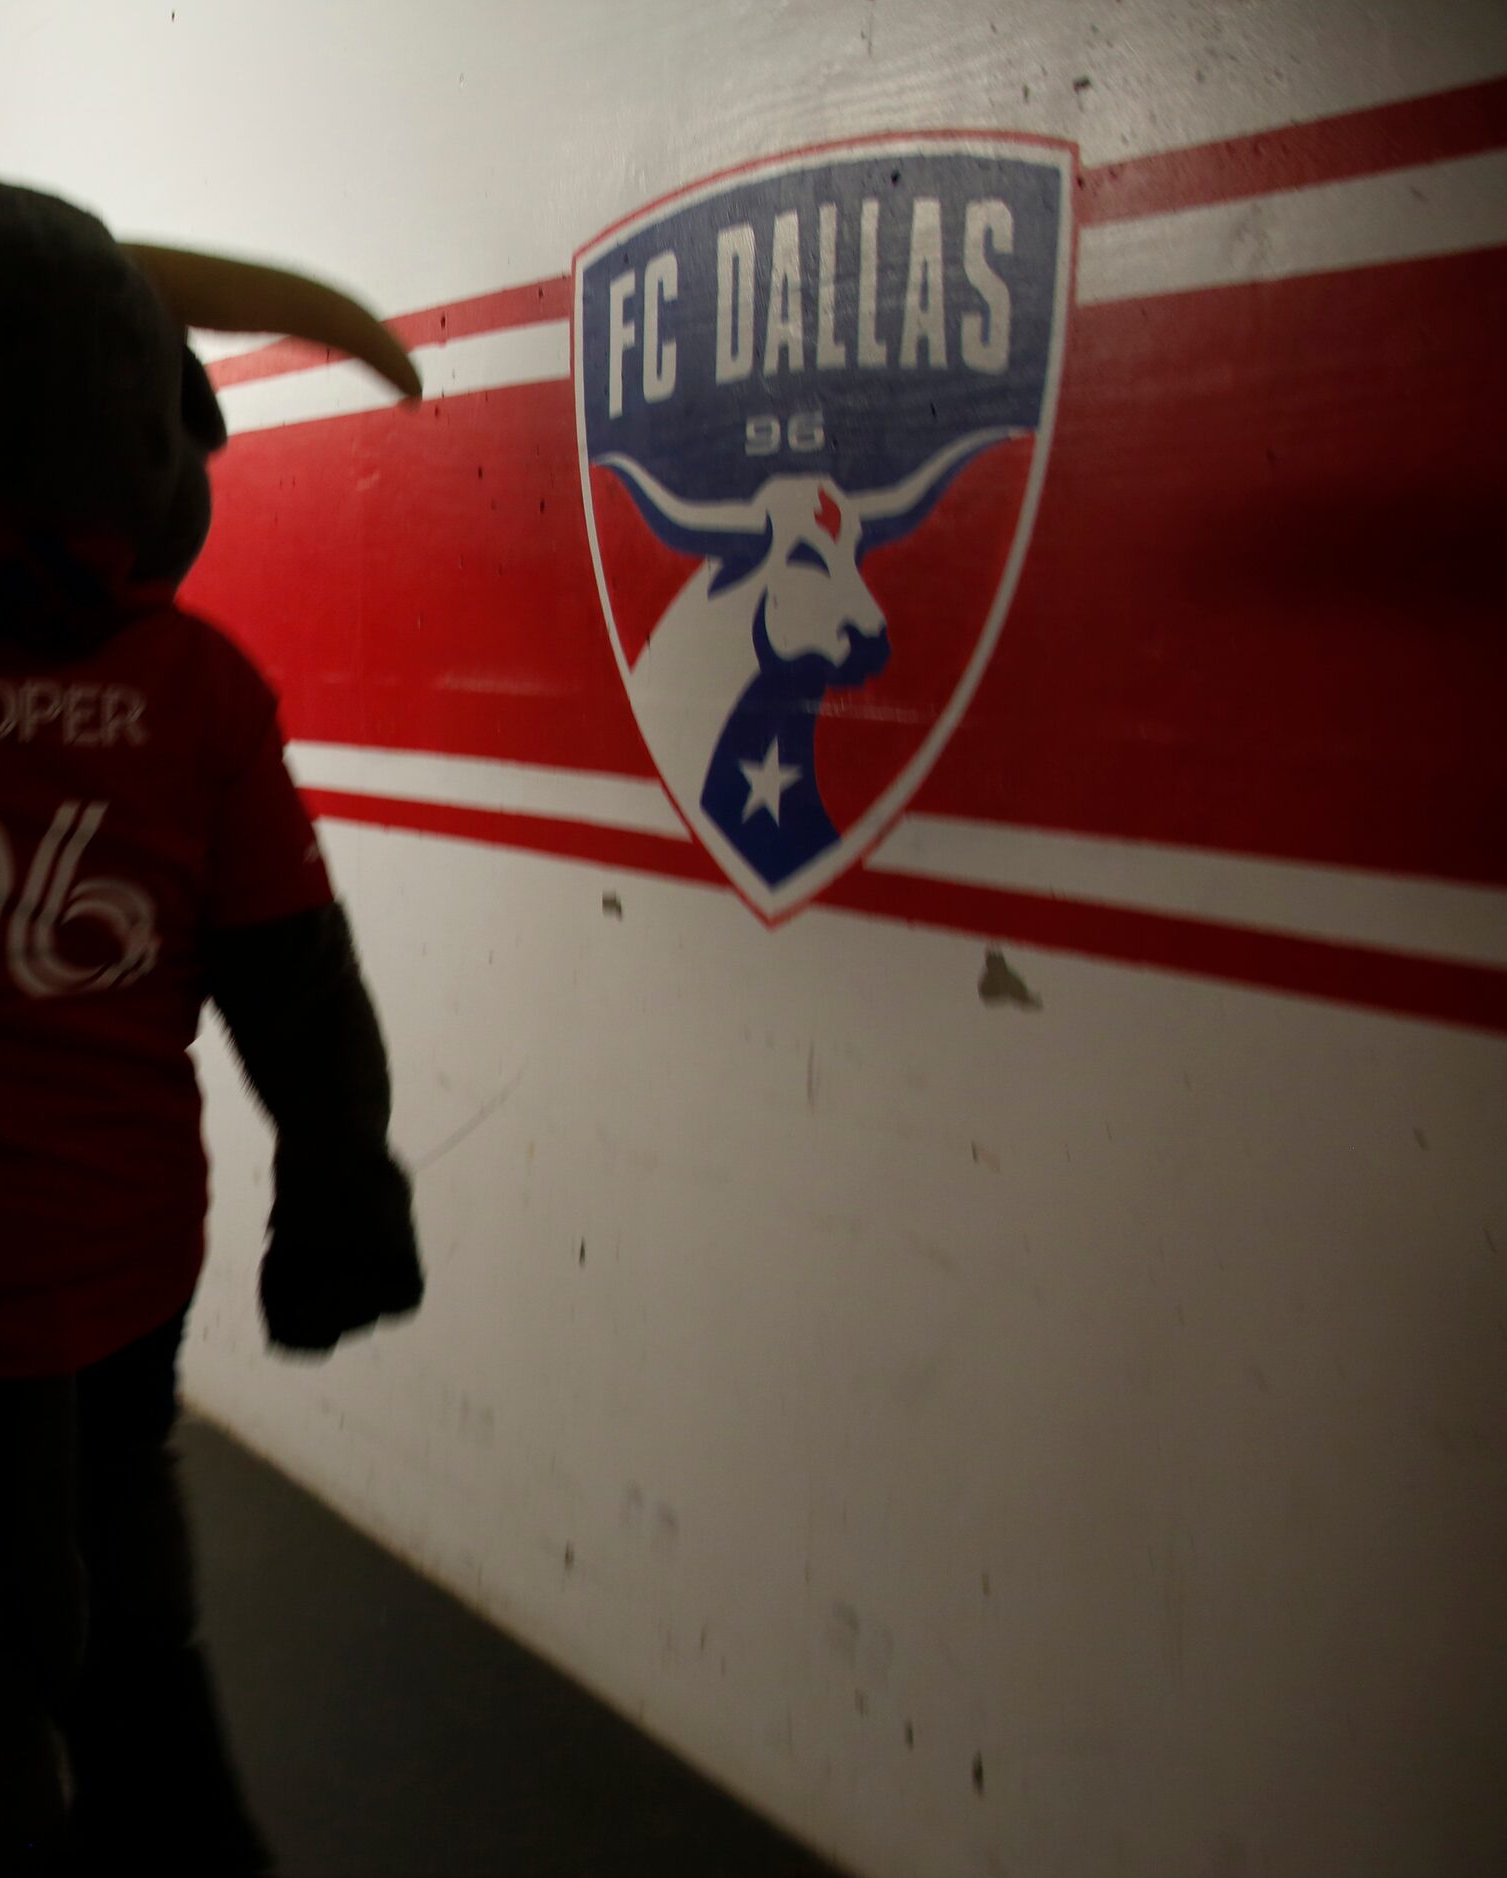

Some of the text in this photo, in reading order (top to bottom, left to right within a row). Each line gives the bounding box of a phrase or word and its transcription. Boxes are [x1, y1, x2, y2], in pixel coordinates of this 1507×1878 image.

[607, 197, 1014, 420] FC DALLAS
[743, 412, 827, 457] 96
